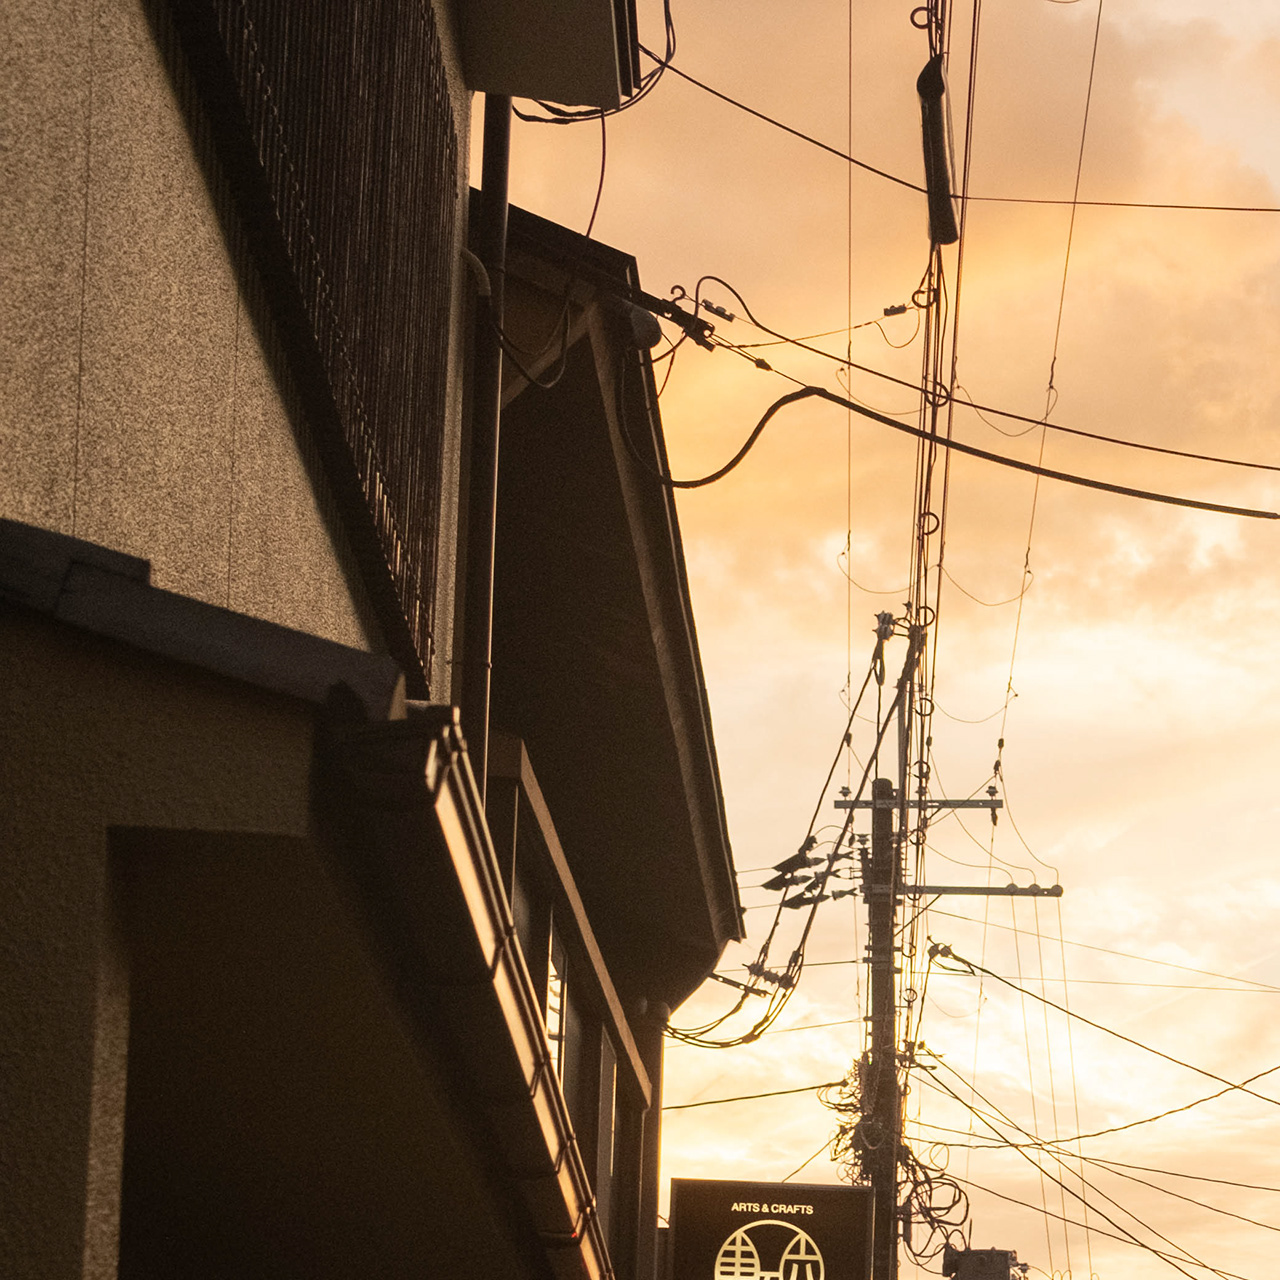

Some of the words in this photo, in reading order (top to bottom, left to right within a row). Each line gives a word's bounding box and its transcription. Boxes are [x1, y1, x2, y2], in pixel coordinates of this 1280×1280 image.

[731, 1202, 760, 1213] ARTS
[761, 1203, 770, 1213] &
[771, 1203, 814, 1215] CRAFTS
